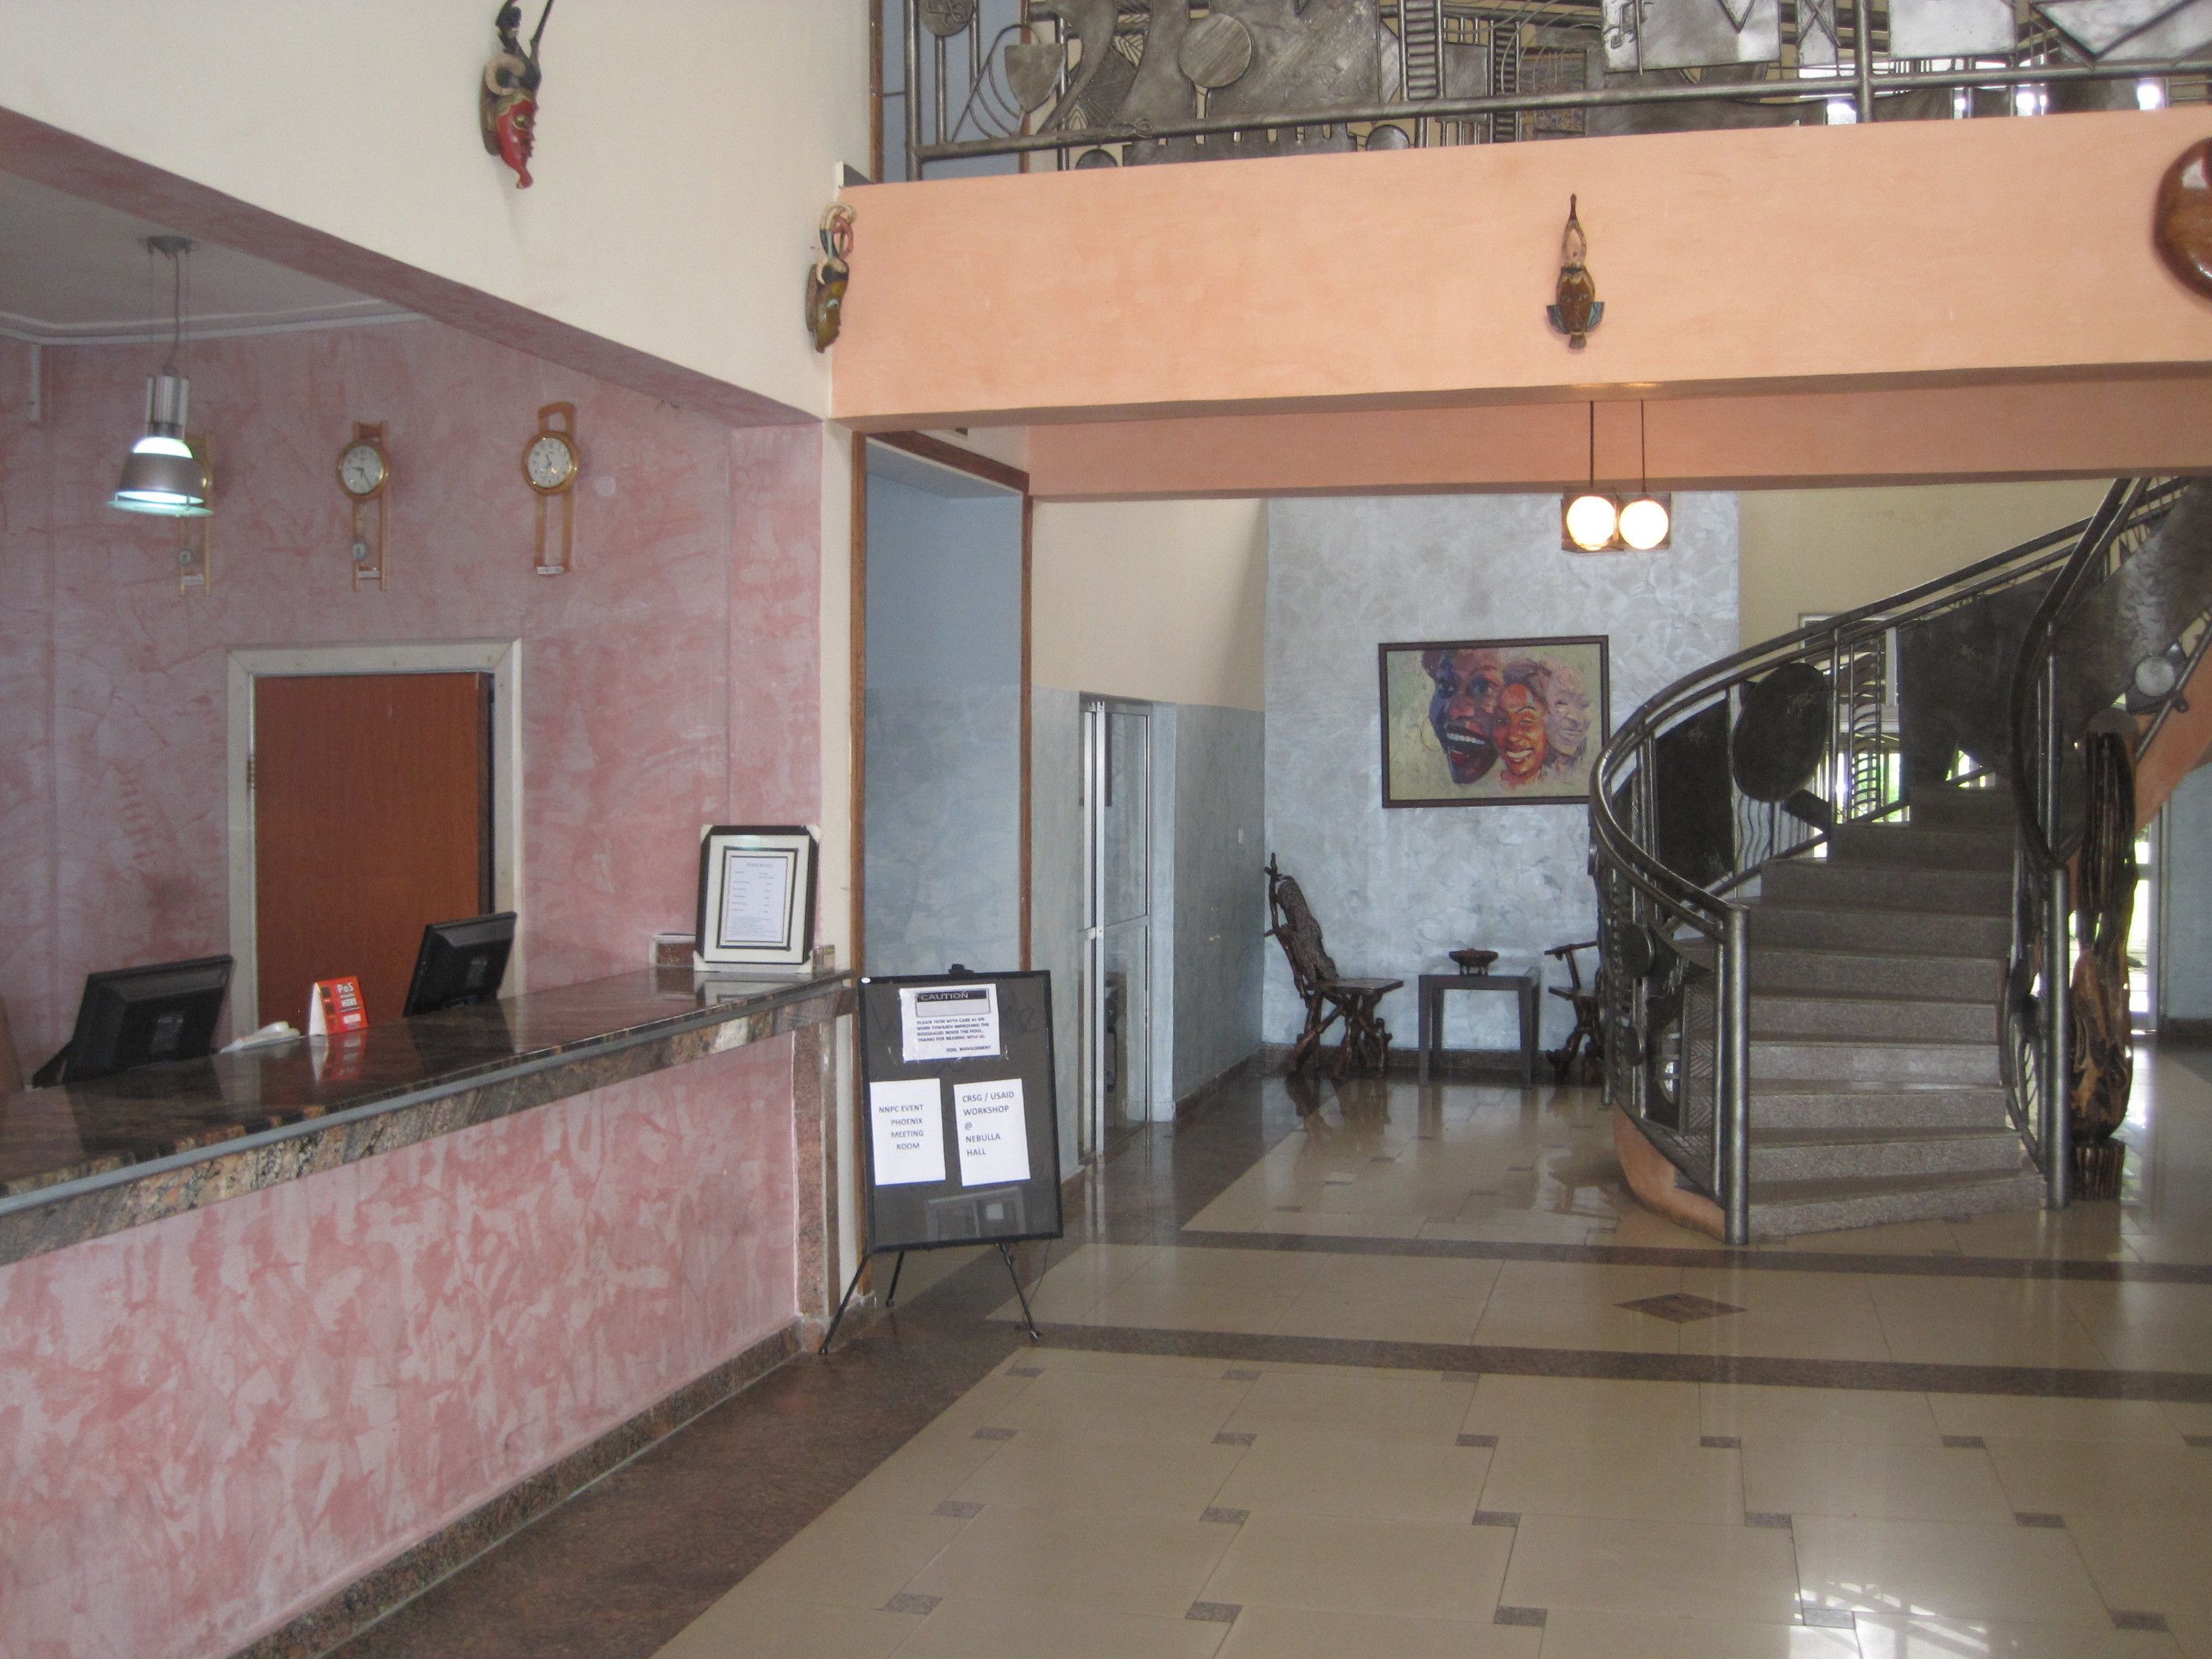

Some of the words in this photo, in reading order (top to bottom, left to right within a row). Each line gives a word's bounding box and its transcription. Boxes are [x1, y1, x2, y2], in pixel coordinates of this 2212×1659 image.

[921, 992, 969, 1001] CAUTION
[991, 1091, 1014, 1100] USAID
[963, 1105, 1009, 1115] WORKSHOP
[965, 1122, 972, 1130] @
[966, 1133, 1001, 1142] NEBULLA
